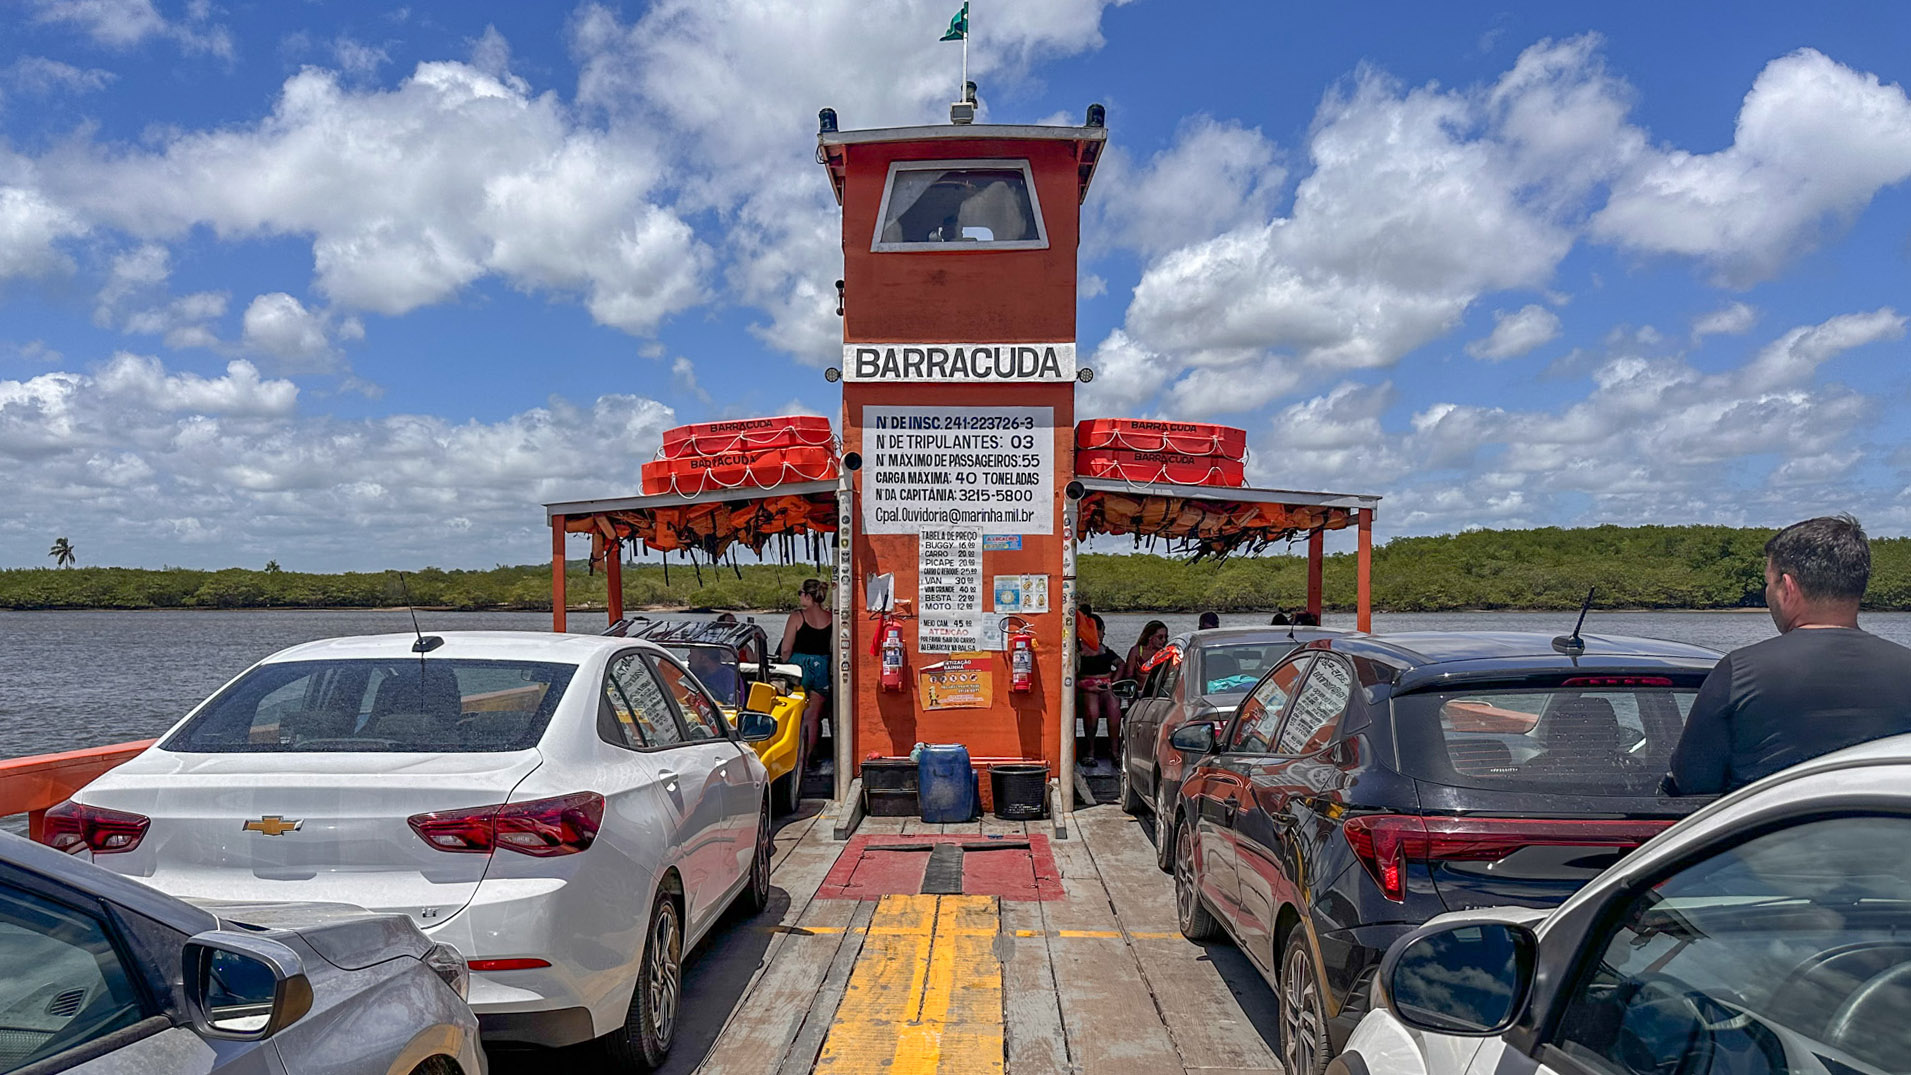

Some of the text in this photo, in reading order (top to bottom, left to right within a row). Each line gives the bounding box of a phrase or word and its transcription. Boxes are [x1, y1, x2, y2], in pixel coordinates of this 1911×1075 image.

[856, 347, 1062, 378] BARRACUDA
[710, 420, 773, 433] BARRACUDA
[891, 416, 906, 429] DE
[908, 416, 943, 430] INSC.
[1131, 421, 1197, 433] BARRACUDA
[889, 435, 904, 449] DE
[906, 434, 1003, 449] TRIPULANTES:
[1010, 435, 1034, 449] 03
[888, 452, 933, 467] MÁXIMO
[934, 453, 947, 467] DE
[1134, 453, 1195, 465] BARRACUDA
[875, 471, 906, 484] CARGA
[955, 472, 977, 485] 40
[982, 472, 1039, 486] TONELADAS
[885, 488, 897, 501] DA
[959, 489, 1033, 502] 3215-5800
[875, 506, 1035, 524] Cpal.Ouvidoria@marinha.mil.br
[921, 531, 946, 540] TABELA
[947, 531, 955, 541] DE
[955, 531, 977, 542] PREÇO
[925, 577, 942, 585] VAN
